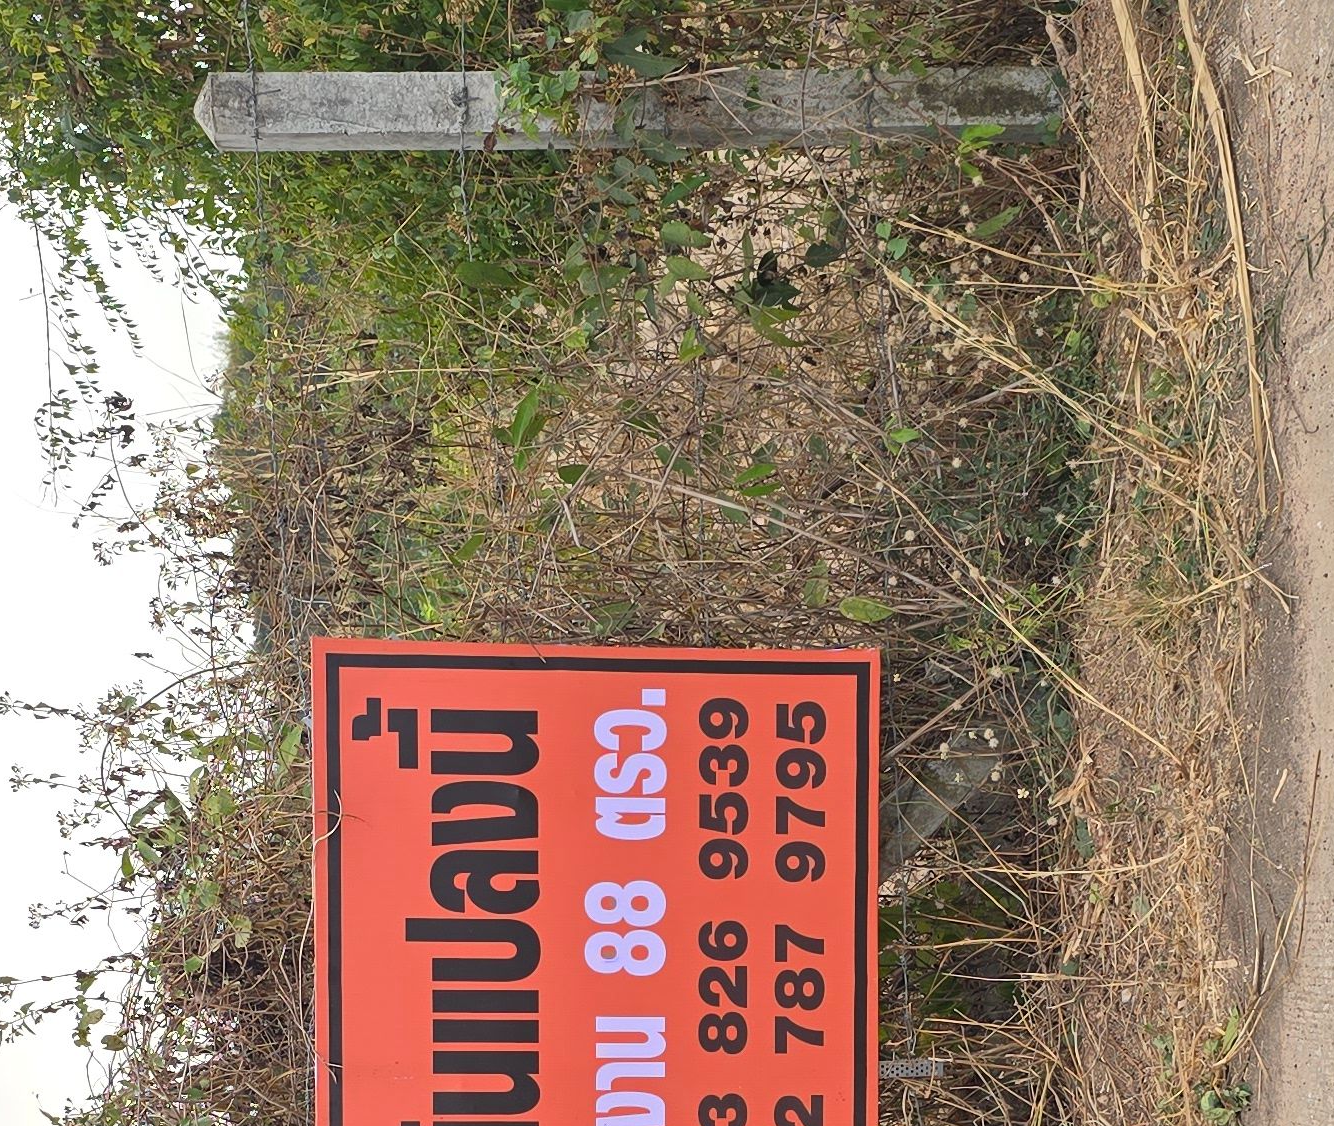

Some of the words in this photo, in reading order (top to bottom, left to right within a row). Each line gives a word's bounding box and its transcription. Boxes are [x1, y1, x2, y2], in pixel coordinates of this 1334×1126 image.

[593, 688, 668, 841] ตรว.
[698, 697, 750, 880] 9539
[774, 701, 827, 883] 9795
[584, 880, 667, 977] 88
[697, 920, 749, 1055] 826
[774, 924, 825, 1054] 787
